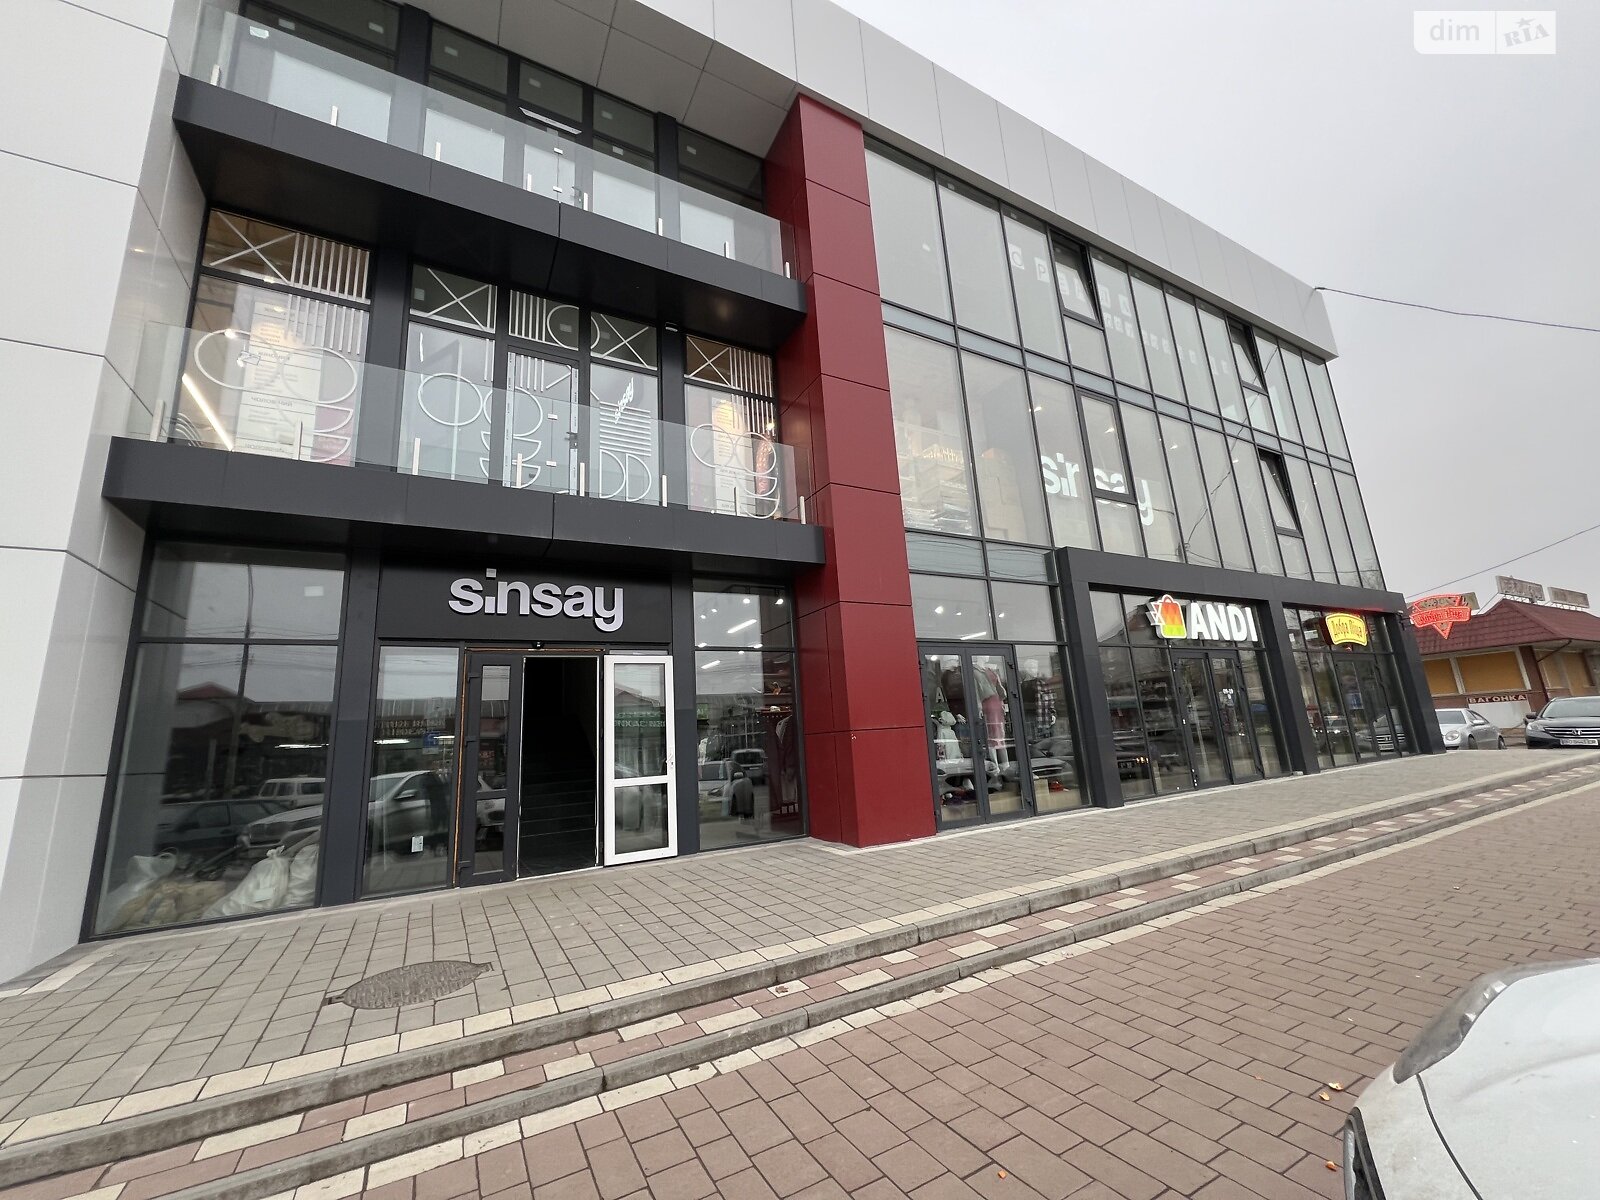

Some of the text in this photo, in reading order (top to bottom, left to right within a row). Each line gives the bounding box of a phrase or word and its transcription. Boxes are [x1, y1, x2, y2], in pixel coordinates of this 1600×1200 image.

[448, 568, 624, 632] sinsay
[1189, 602, 1258, 642] ANDI
[1468, 694, 1526, 704] ВАГОНКА
